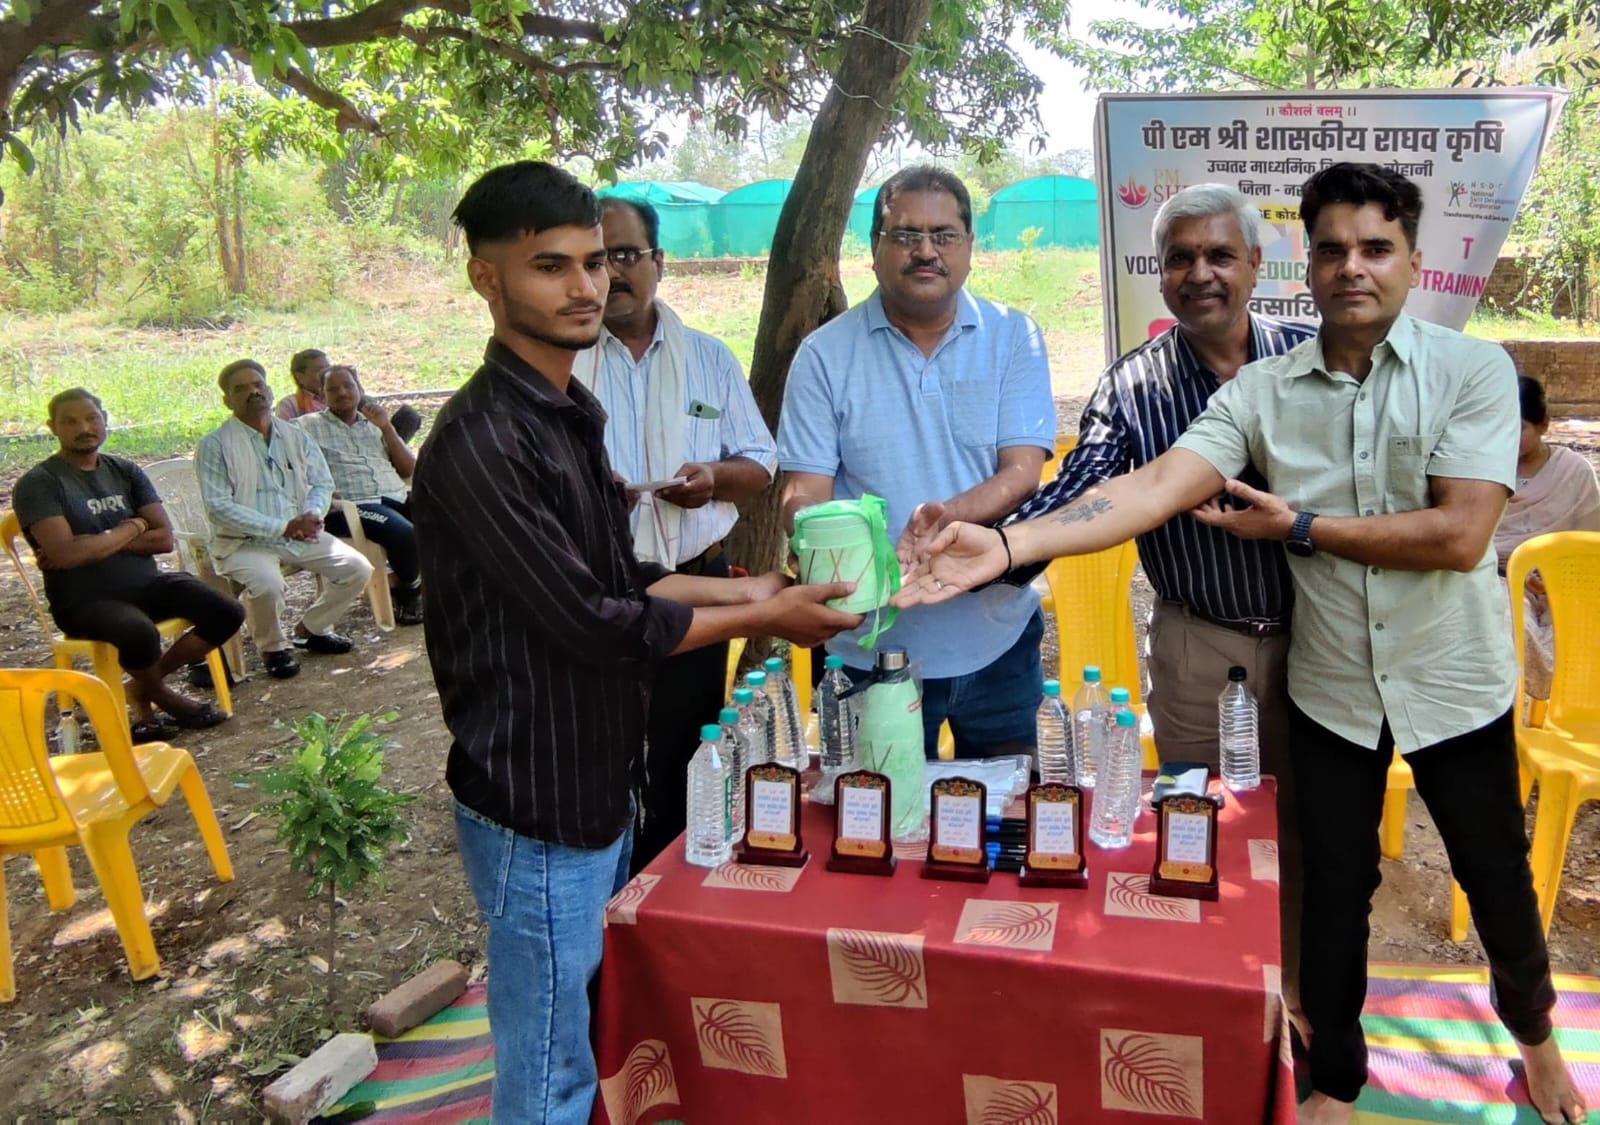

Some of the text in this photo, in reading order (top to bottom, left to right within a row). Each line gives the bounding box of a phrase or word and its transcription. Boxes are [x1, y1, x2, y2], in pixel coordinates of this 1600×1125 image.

[1142, 119, 1505, 162] पी एम श्री शासकीय राघव कृषि
[1153, 168, 1180, 185] PM
[1207, 160, 1247, 174] उच्चतर
[1250, 158, 1317, 175] माध्यमिक
[1239, 179, 1272, 197] जिला
[1124, 255, 1487, 298] VOC EDUC TRAININ
[1248, 292, 1319, 319] वसायि
